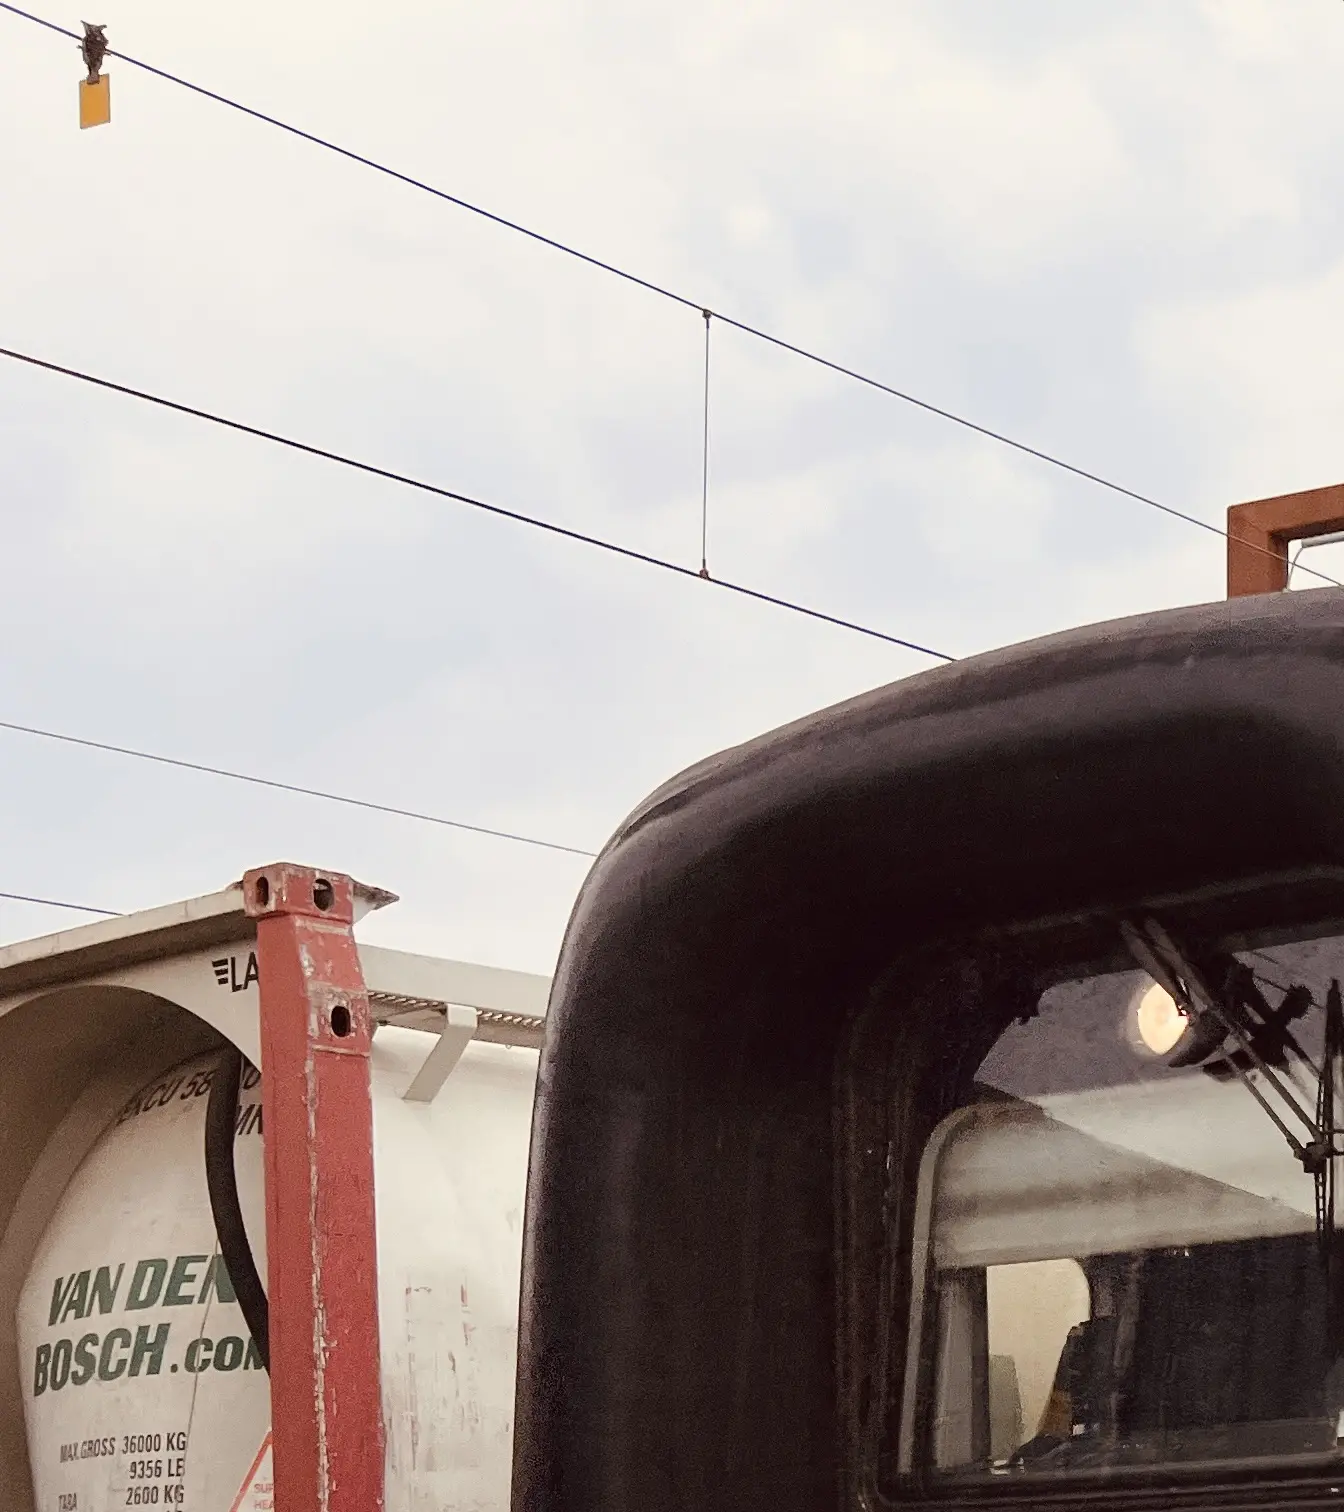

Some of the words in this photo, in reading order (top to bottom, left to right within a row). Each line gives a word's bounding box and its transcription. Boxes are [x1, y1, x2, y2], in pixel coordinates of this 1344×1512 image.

[48, 1262, 126, 1327] VAN
[124, 1253, 238, 1312] DEN
[122, 1433, 162, 1455] 36000
[166, 1432, 187, 1452] KG
[126, 1485, 160, 1506] 2600
[164, 1484, 185, 1504] KG
